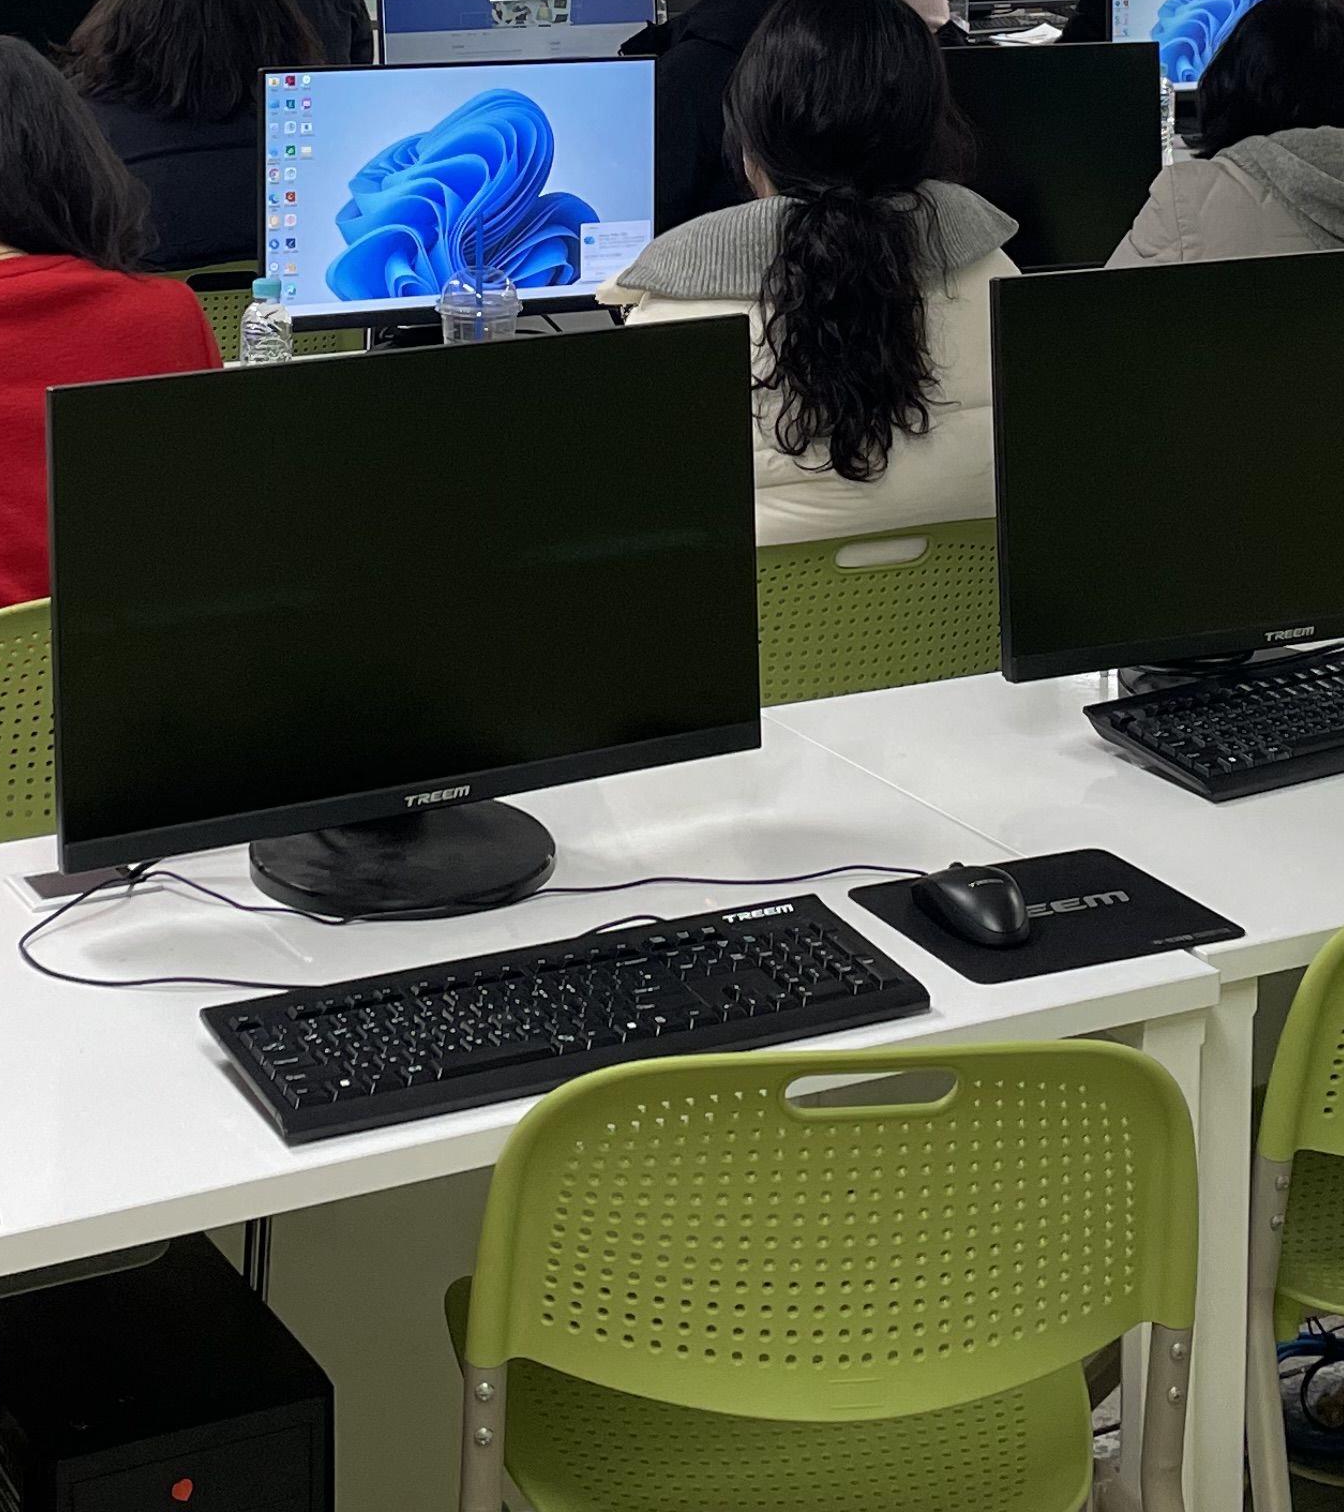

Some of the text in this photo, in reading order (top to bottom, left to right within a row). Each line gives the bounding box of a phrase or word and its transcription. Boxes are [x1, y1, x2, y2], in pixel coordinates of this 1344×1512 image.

[1264, 626, 1315, 642] TREEM
[404, 785, 470, 808] TREEM
[722, 903, 794, 924] TREEM
[1027, 890, 1131, 919] EEM
